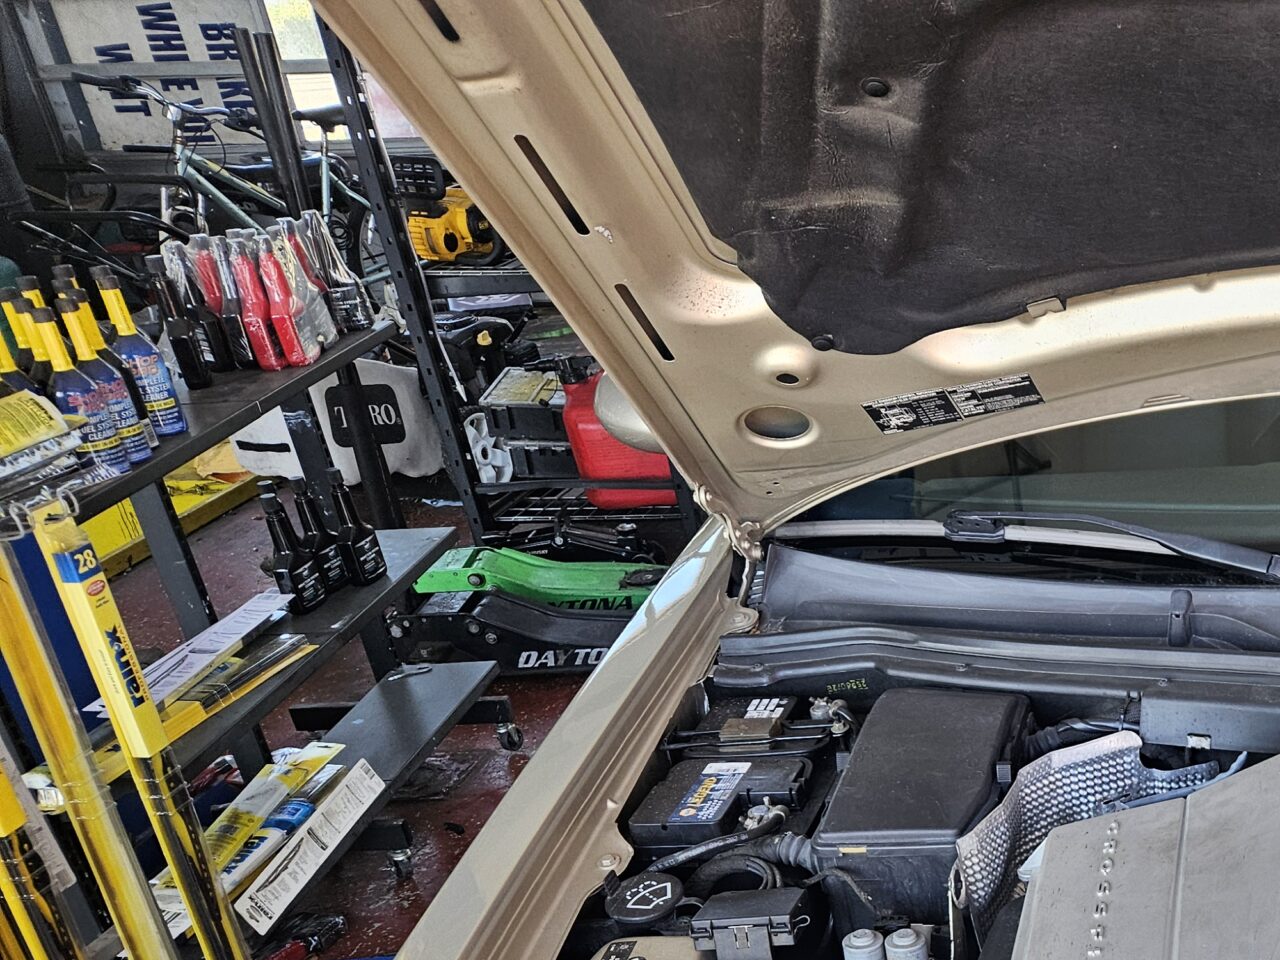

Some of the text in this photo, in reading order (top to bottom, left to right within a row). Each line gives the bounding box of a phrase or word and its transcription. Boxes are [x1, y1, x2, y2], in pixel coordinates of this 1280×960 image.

[136, 2, 199, 91] WHIE
[94, 43, 152, 117] WIT
[334, 403, 397, 429] TRO
[74, 549, 98, 575] 28
[517, 647, 610, 669] DAYTO
